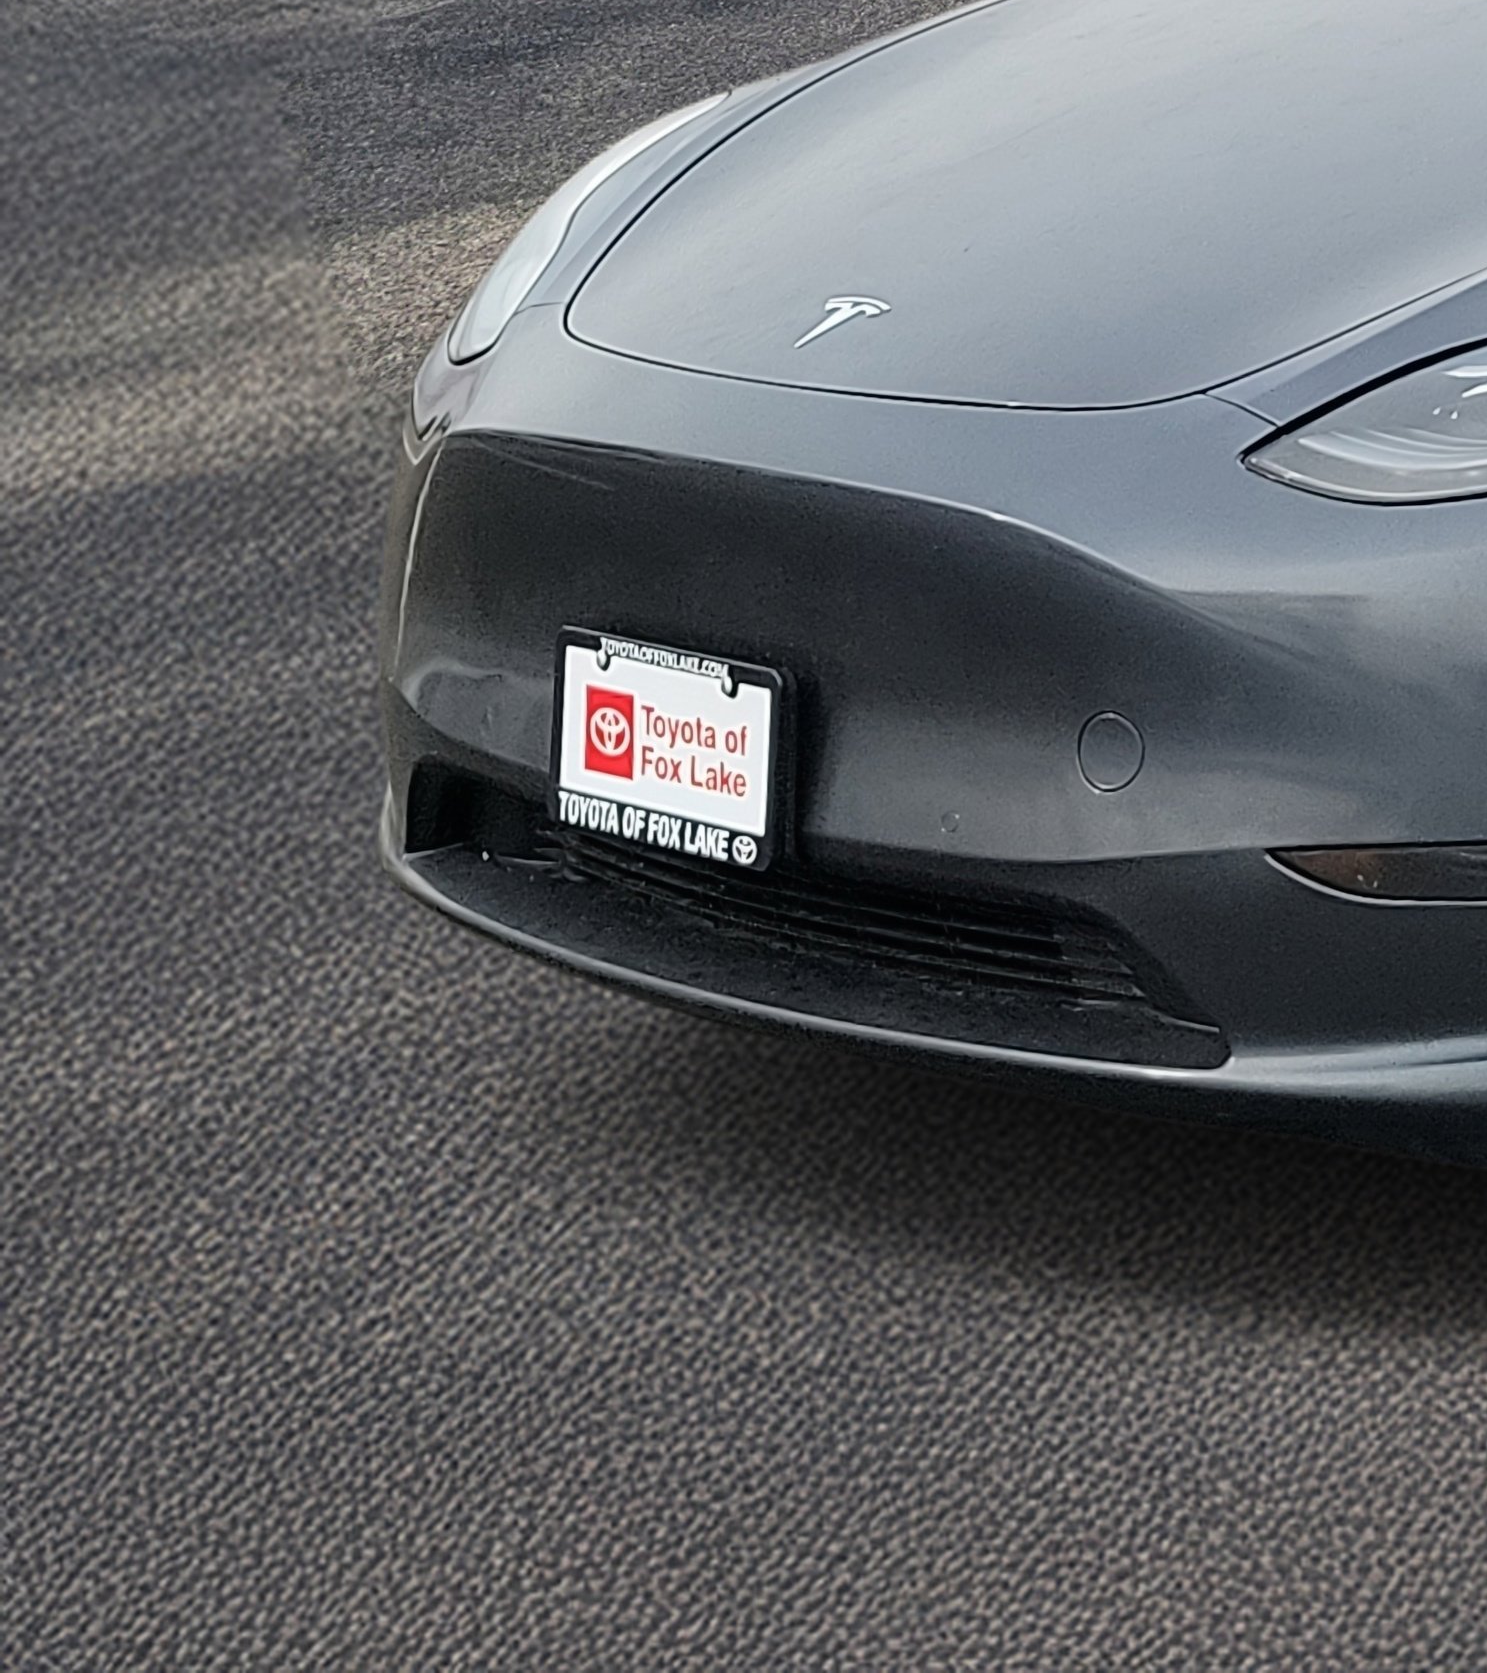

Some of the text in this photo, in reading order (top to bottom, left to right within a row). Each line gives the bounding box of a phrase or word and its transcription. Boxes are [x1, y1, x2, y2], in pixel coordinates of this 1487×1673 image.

[640, 705, 747, 756] Toyota of
[641, 746, 747, 797] Fox Lake
[558, 790, 730, 860] TOYOTA OF FOX LAKE
